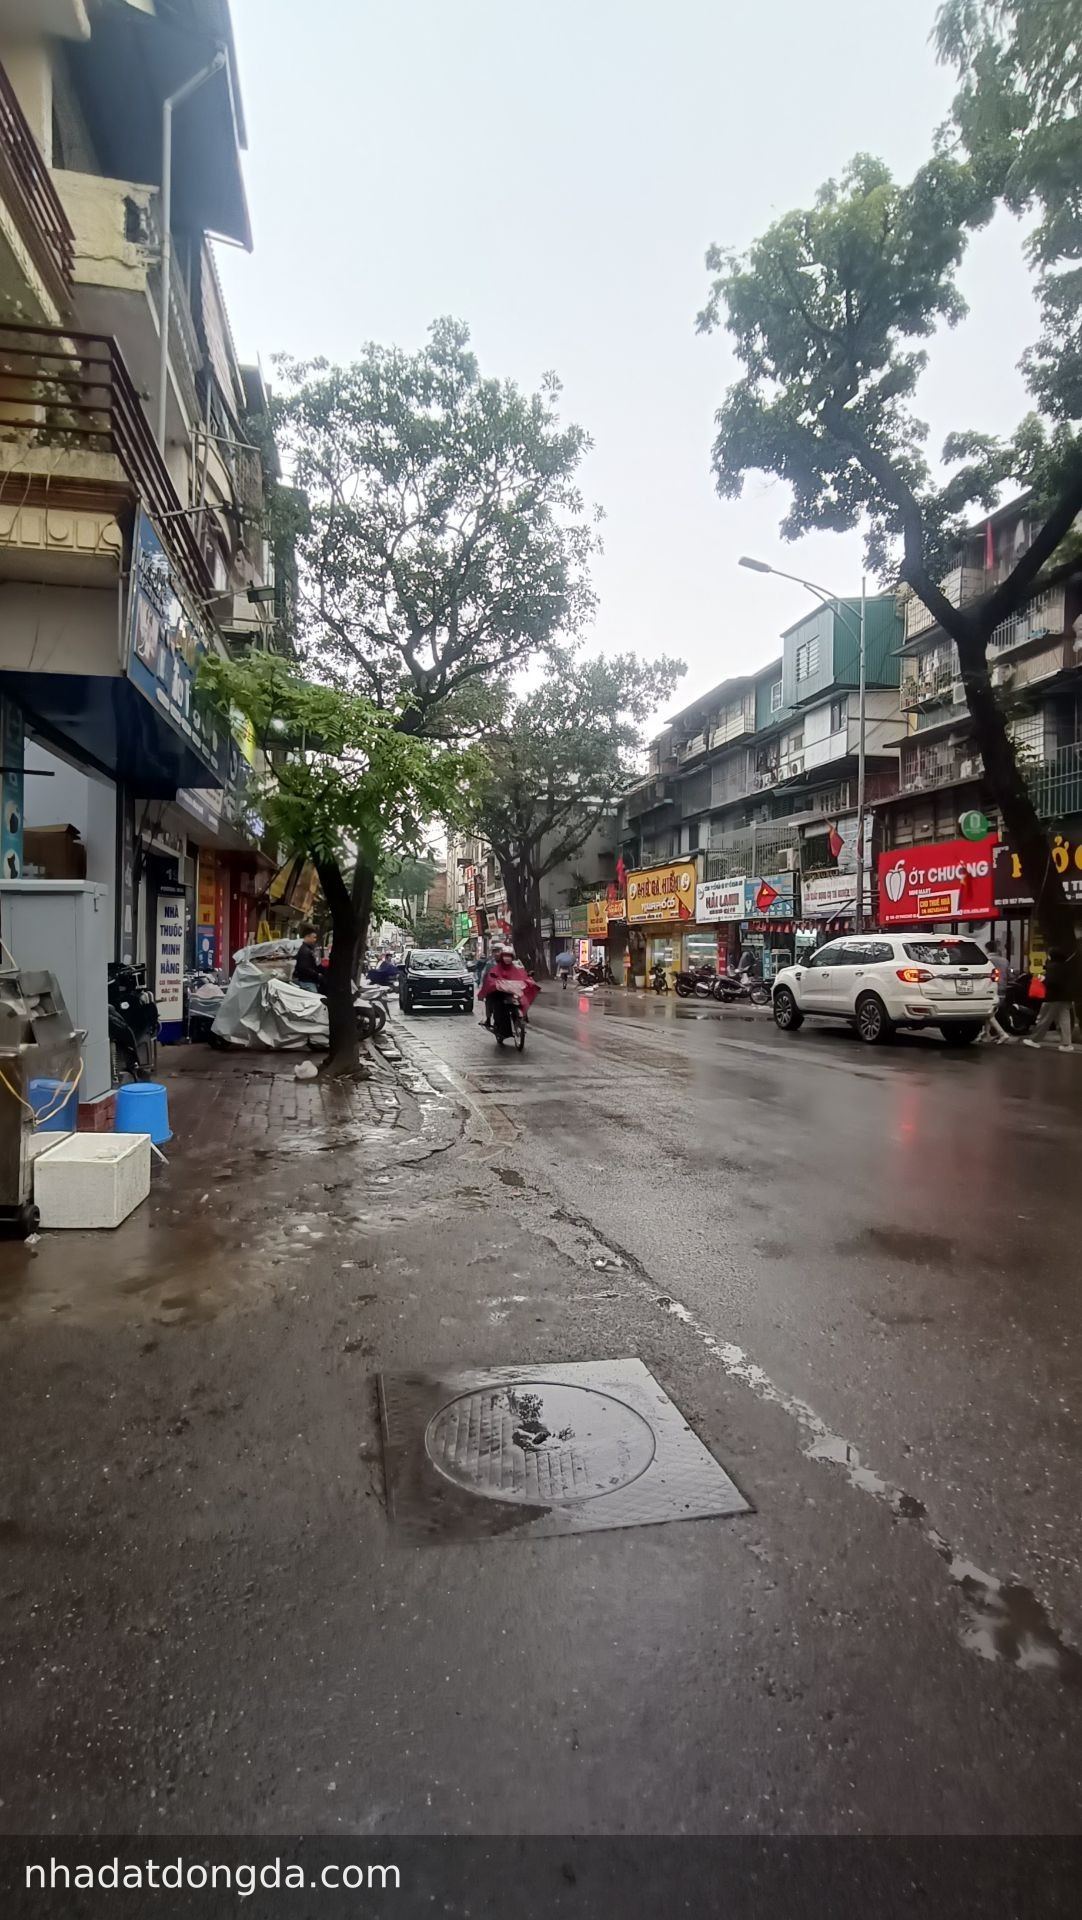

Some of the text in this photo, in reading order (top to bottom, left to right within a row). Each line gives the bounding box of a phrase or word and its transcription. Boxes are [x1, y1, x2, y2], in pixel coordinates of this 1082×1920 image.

[908, 866, 925, 885] ỚT
[164, 904, 179, 918] NHÀ
[160, 922, 183, 937] THUỐC
[161, 943, 181, 955] MINH
